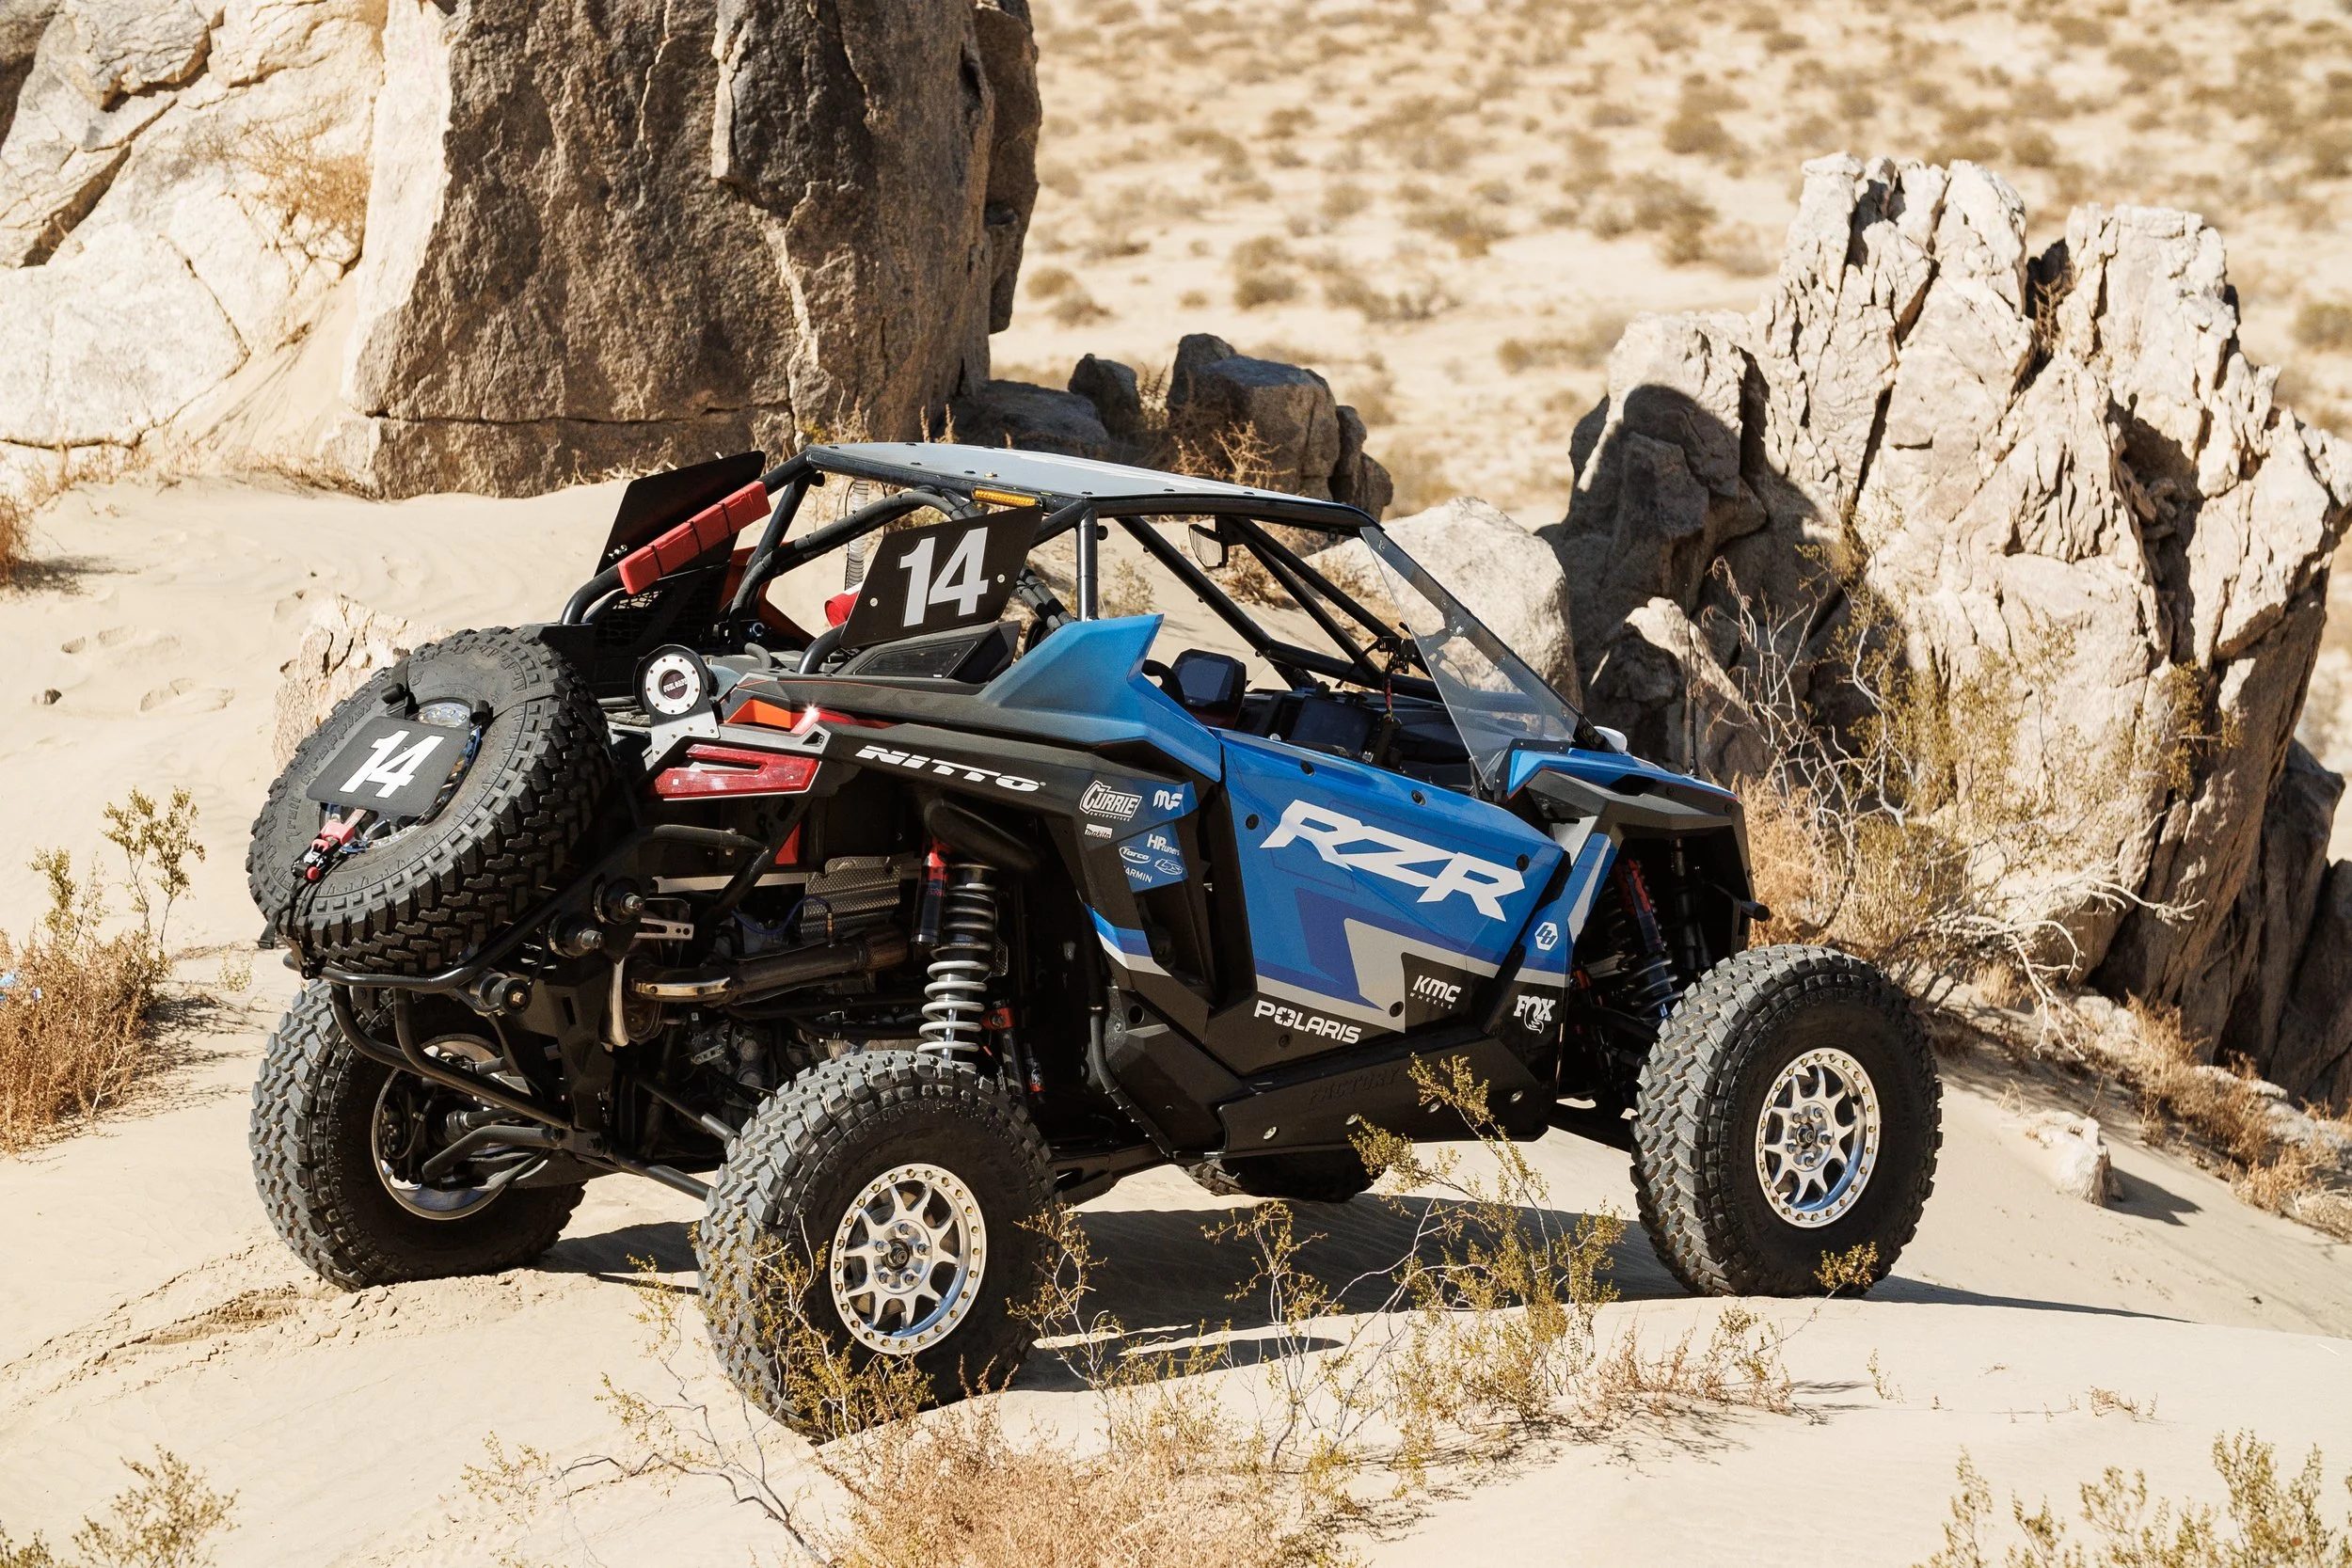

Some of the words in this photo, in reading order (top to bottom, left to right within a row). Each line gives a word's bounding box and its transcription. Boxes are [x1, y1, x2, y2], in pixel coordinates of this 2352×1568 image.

[898, 525, 991, 628] 14
[339, 729, 445, 800] 14
[854, 744, 1041, 793] NITTO
[1123, 864, 1152, 884] ARMIN
[1259, 799, 1526, 923] RZR
[1409, 992, 1453, 1010] WHEELS
[1413, 974, 1461, 1004] KMC
[1253, 999, 1362, 1045] POLARIS
[1513, 994, 1556, 1031] FOX
